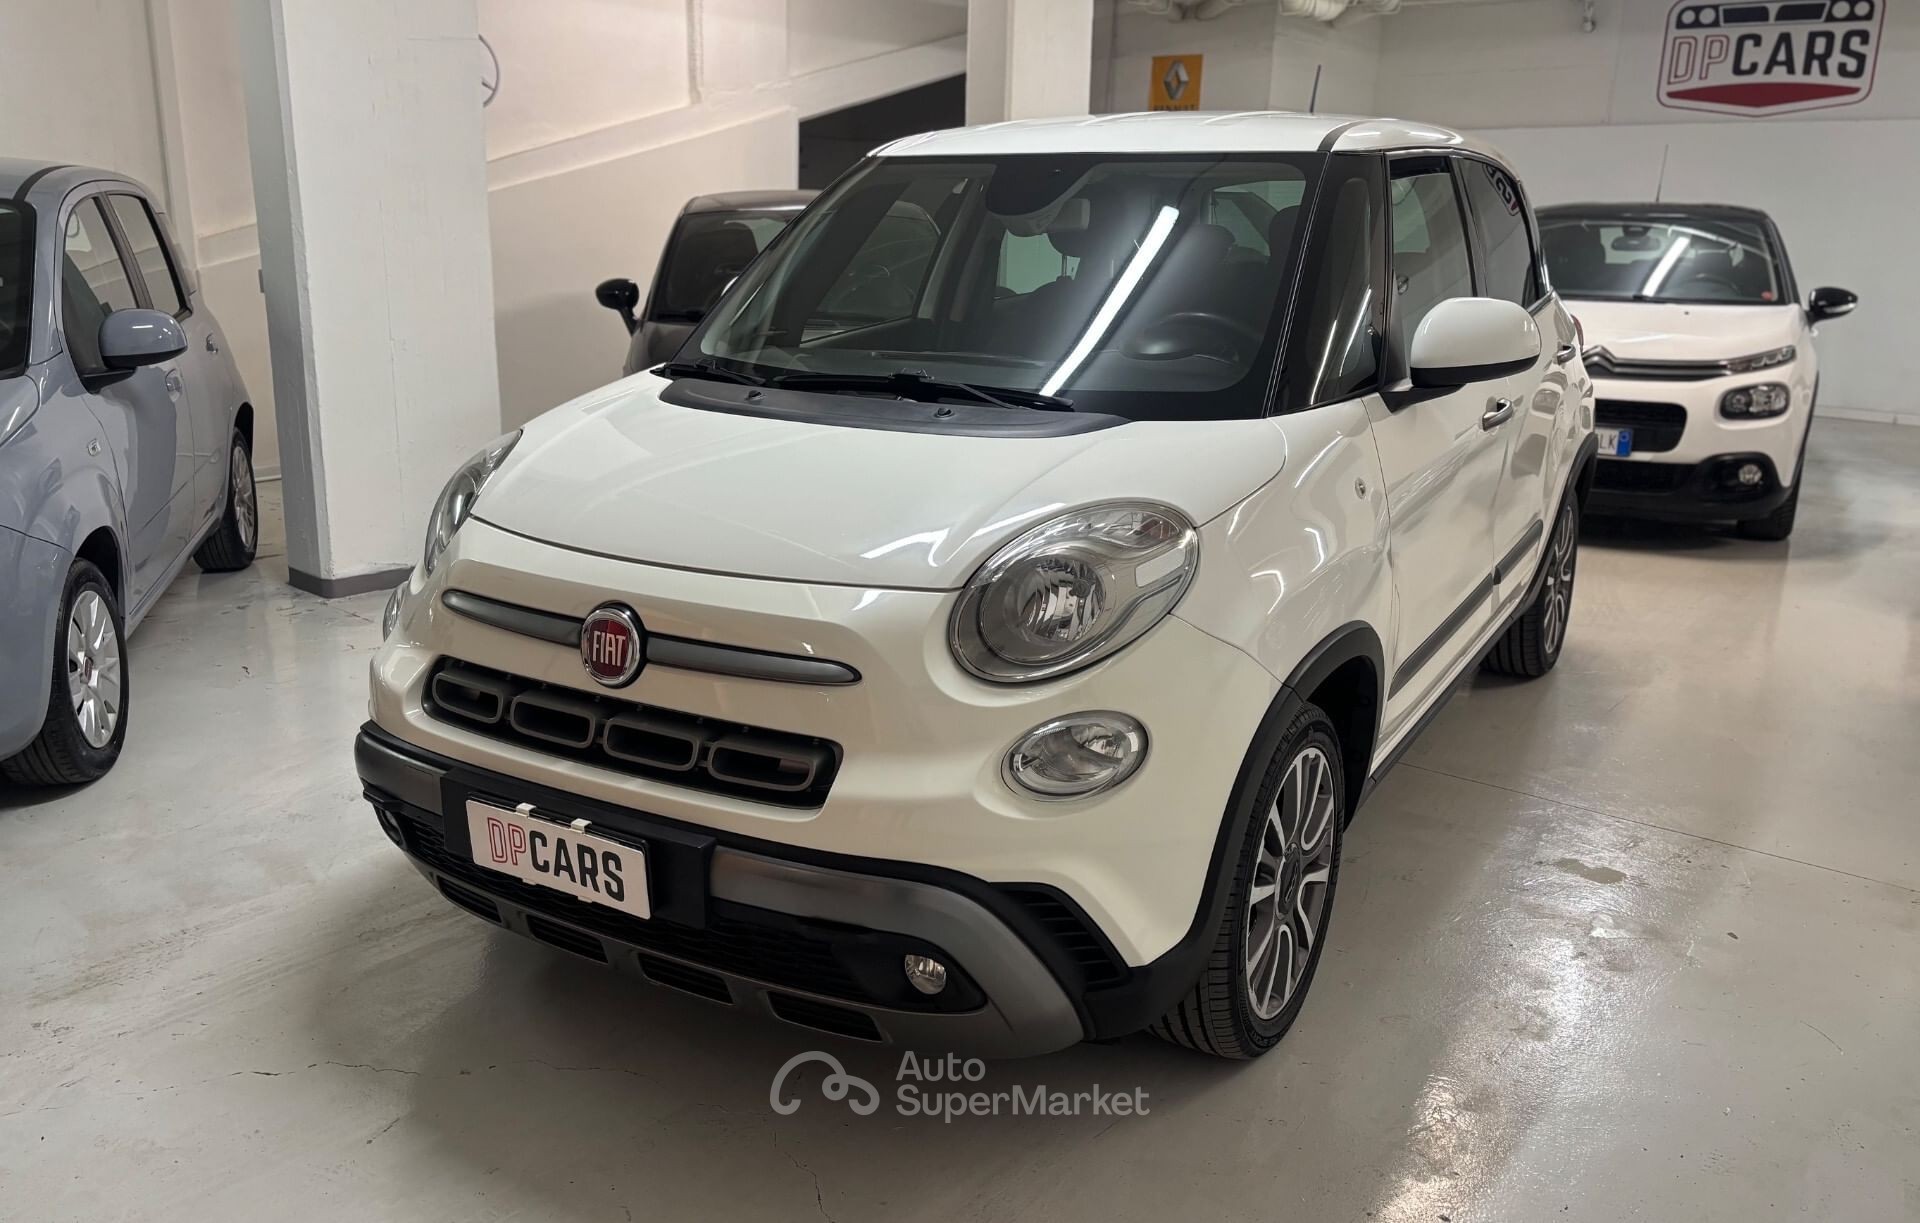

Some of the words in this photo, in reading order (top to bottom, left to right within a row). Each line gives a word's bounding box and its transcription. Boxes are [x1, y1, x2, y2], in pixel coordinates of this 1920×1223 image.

[1667, 29, 1870, 85] DPCARS
[592, 630, 626, 667] FIAT
[487, 817, 625, 902] DPCARS
